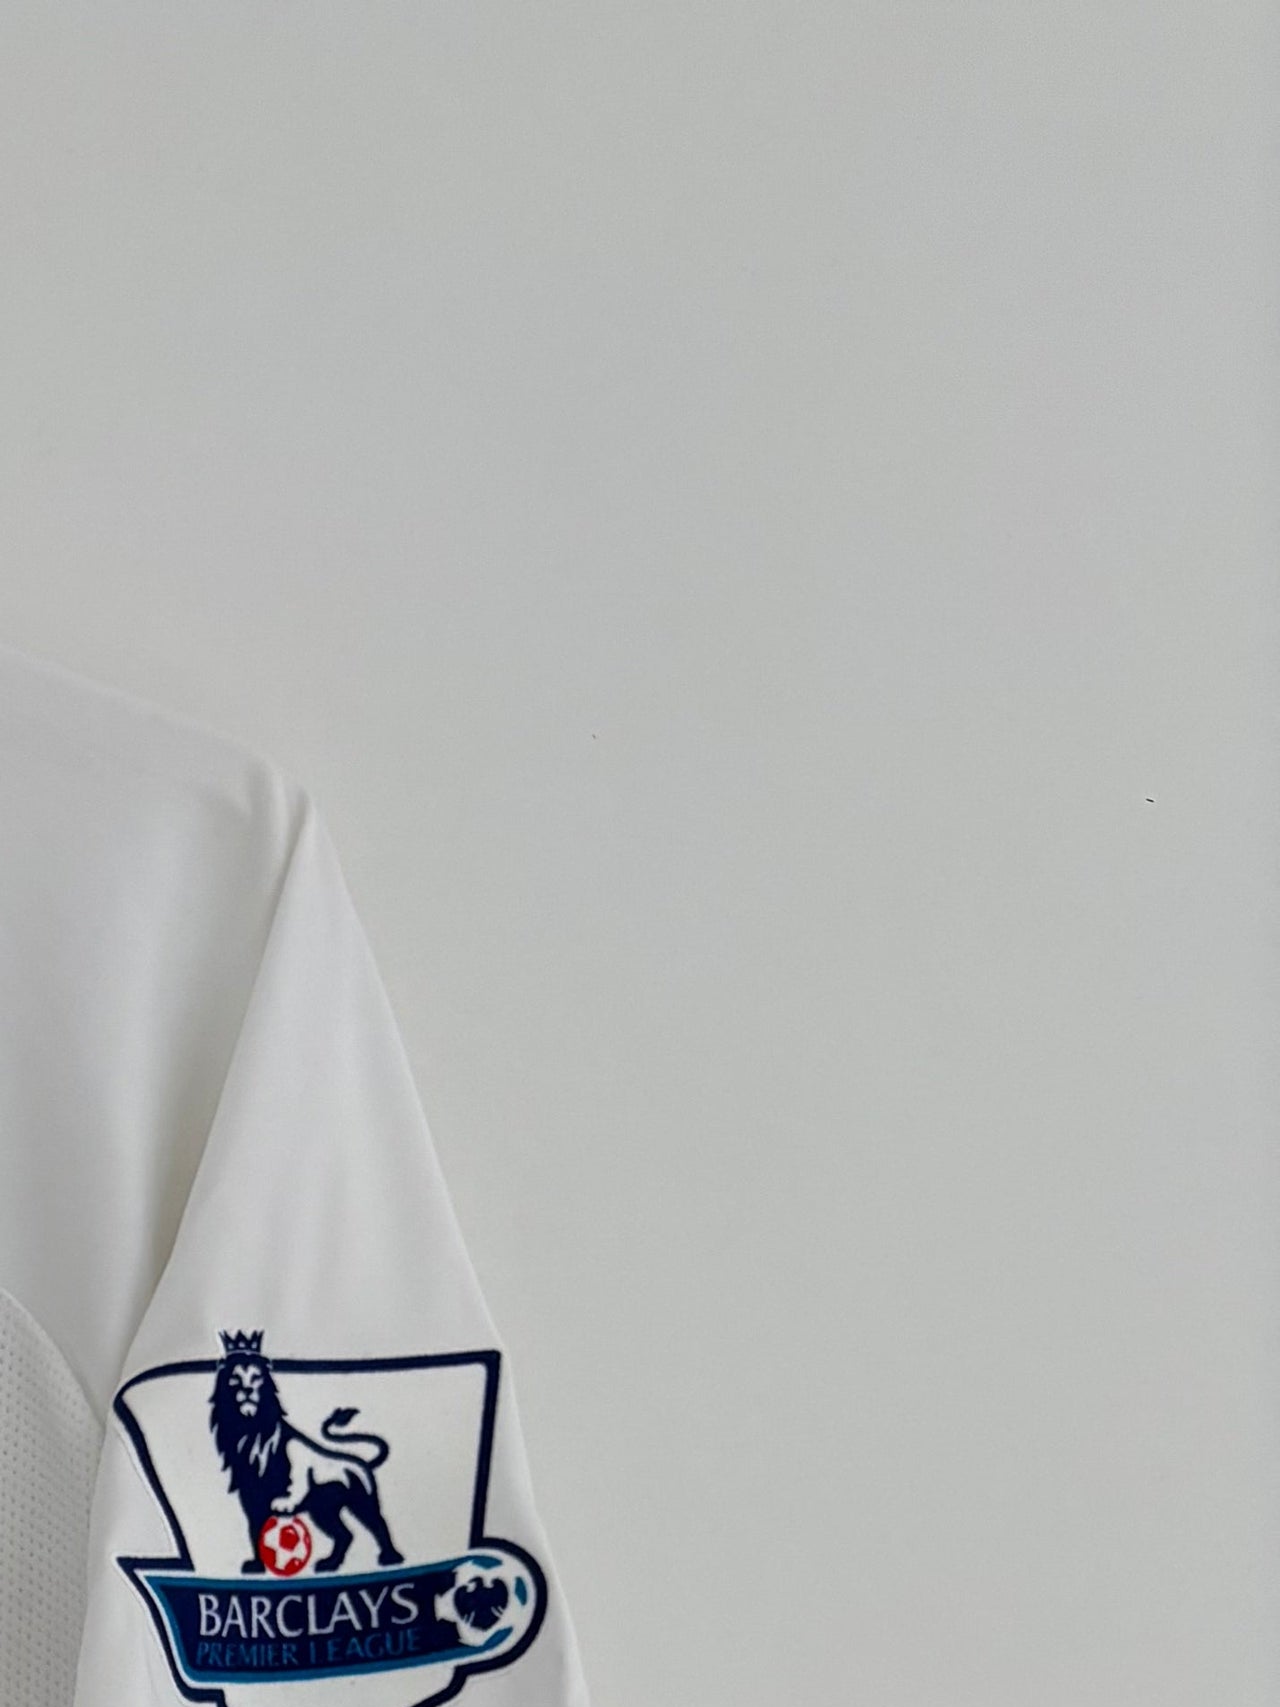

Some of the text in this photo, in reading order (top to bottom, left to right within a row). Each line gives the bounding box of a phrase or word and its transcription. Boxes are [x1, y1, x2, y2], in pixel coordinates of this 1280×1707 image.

[197, 1582, 419, 1640] BARCLAYS
[195, 1627, 422, 1667] PREMIER LEAGUE
